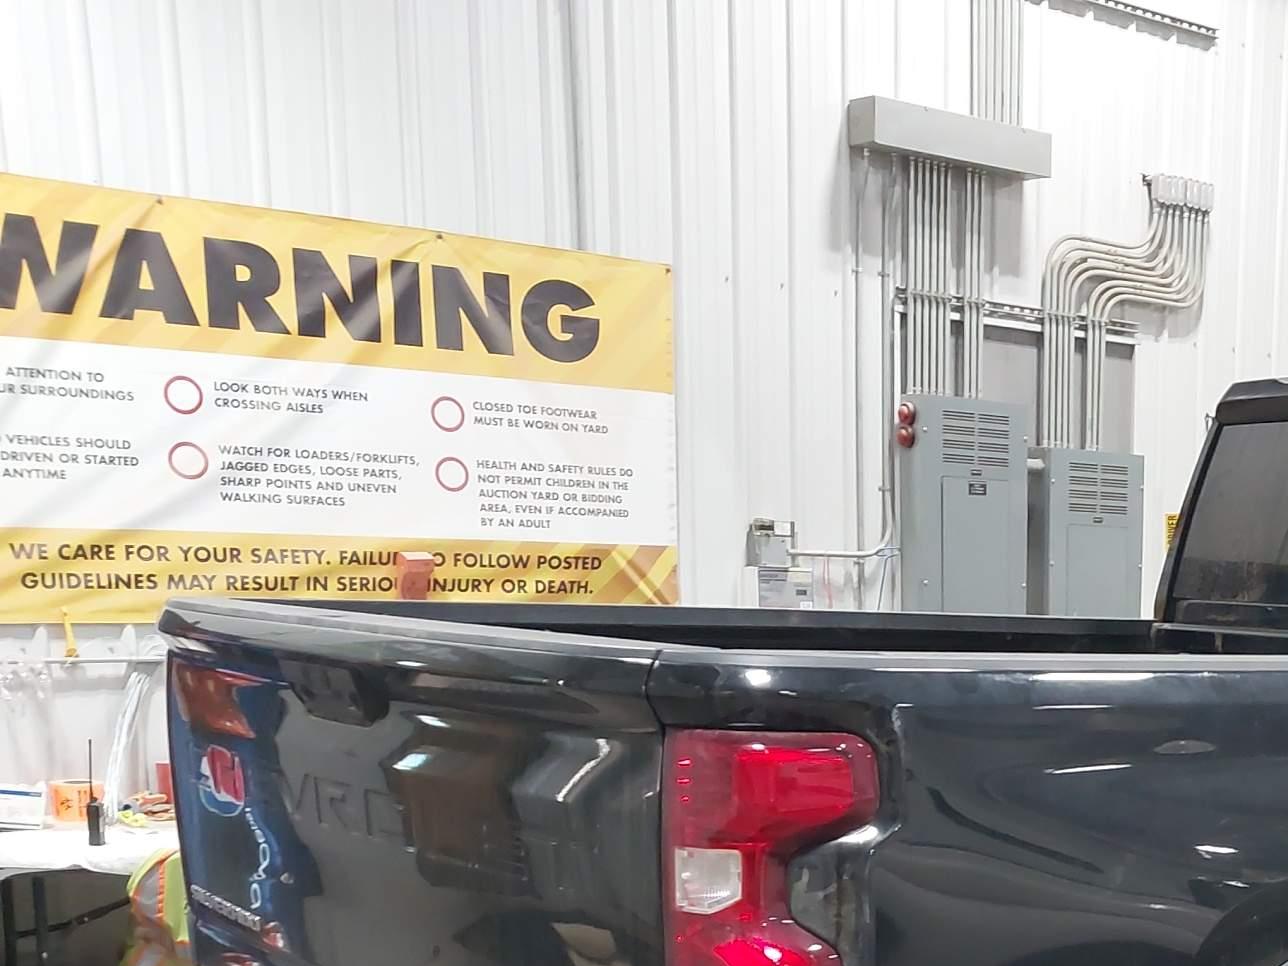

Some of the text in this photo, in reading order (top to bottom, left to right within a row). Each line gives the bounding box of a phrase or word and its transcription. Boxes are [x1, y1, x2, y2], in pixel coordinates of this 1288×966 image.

[0, 212, 601, 364] WARNING
[6, 366, 105, 383] ATTENTION TO
[20, 383, 135, 402] SURROUNDINGS
[214, 381, 369, 402] LOOK BOTH WAYS WHEN
[214, 397, 324, 414] CROSSING AISLES
[473, 401, 598, 420] CLOSED TOE FOOTWEAR
[473, 416, 609, 435] MUST BE WORN ON YARD
[6, 434, 132, 450] VEHICLES SHOULD
[0, 451, 140, 467] DRIVEN OR STARTED
[218, 445, 421, 468] WATCH FOR LOADERS/FORKLIFTS,
[2, 468, 67, 480] ANYTIME
[220, 461, 403, 481] JAGGED EDGES, LOOSE PARTS,
[476, 460, 634, 478] HEALTH AND SAFETY RULES DO
[220, 476, 398, 494] SHARP POINTS AND UNEVEN
[478, 474, 630, 491] NOT PERMIT CHILDREN IN THE
[220, 491, 346, 507] WALKING SURFACES
[479, 489, 623, 505] AUCTION YARD OR BIDDING
[480, 503, 630, 518] AREA, EVEN IF ACCOMPANIED
[480, 517, 552, 529] BY AN ADULT
[9, 543, 49, 562] WE
[58, 544, 116, 562] CARE
[125, 544, 172, 562] FOR
[179, 545, 243, 564] YOUR
[251, 547, 331, 566] SAFETY.
[432, 552, 446, 568] O
[453, 552, 531, 570] FOLLOW
[537, 555, 602, 571] POSTED
[21, 571, 594, 595] GUIDELINES MAY RESULT IN SERIO INJURY OR DEATH.
